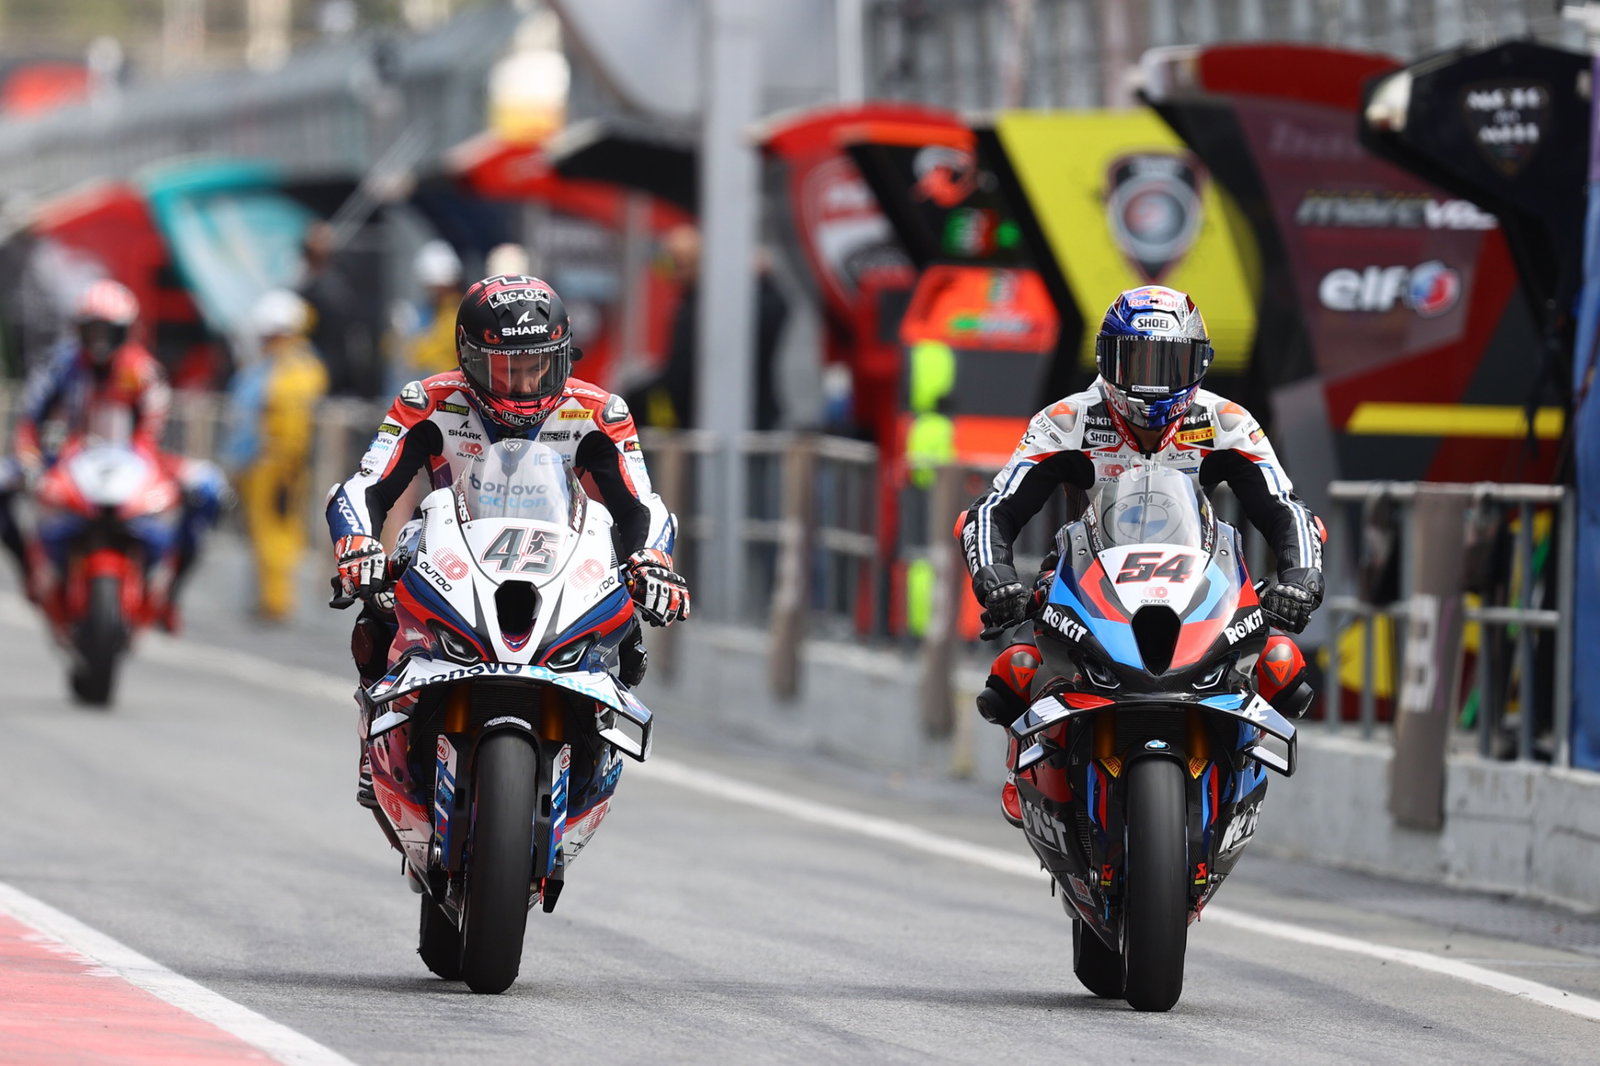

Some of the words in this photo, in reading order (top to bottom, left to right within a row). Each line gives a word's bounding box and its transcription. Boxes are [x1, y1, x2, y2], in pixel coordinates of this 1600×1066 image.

[1318, 266, 1409, 312] elf
[1129, 299, 1152, 307] Red
[501, 324, 548, 336] SHARK
[1137, 318, 1169, 330] SHOEI
[1166, 336, 1192, 345] WINGS
[480, 347, 522, 355] BISCHOFF
[528, 346, 560, 355] SCHECK
[505, 409, 548, 425] Muc-Off
[561, 410, 590, 419] PIRELLI
[448, 429, 482, 441] SHARK
[1090, 432, 1116, 443] SHOEI
[1180, 429, 1213, 441] PIRELLI
[481, 527, 560, 577] 45
[1115, 551, 1197, 584] 54
[419, 560, 453, 593] OUTDO
